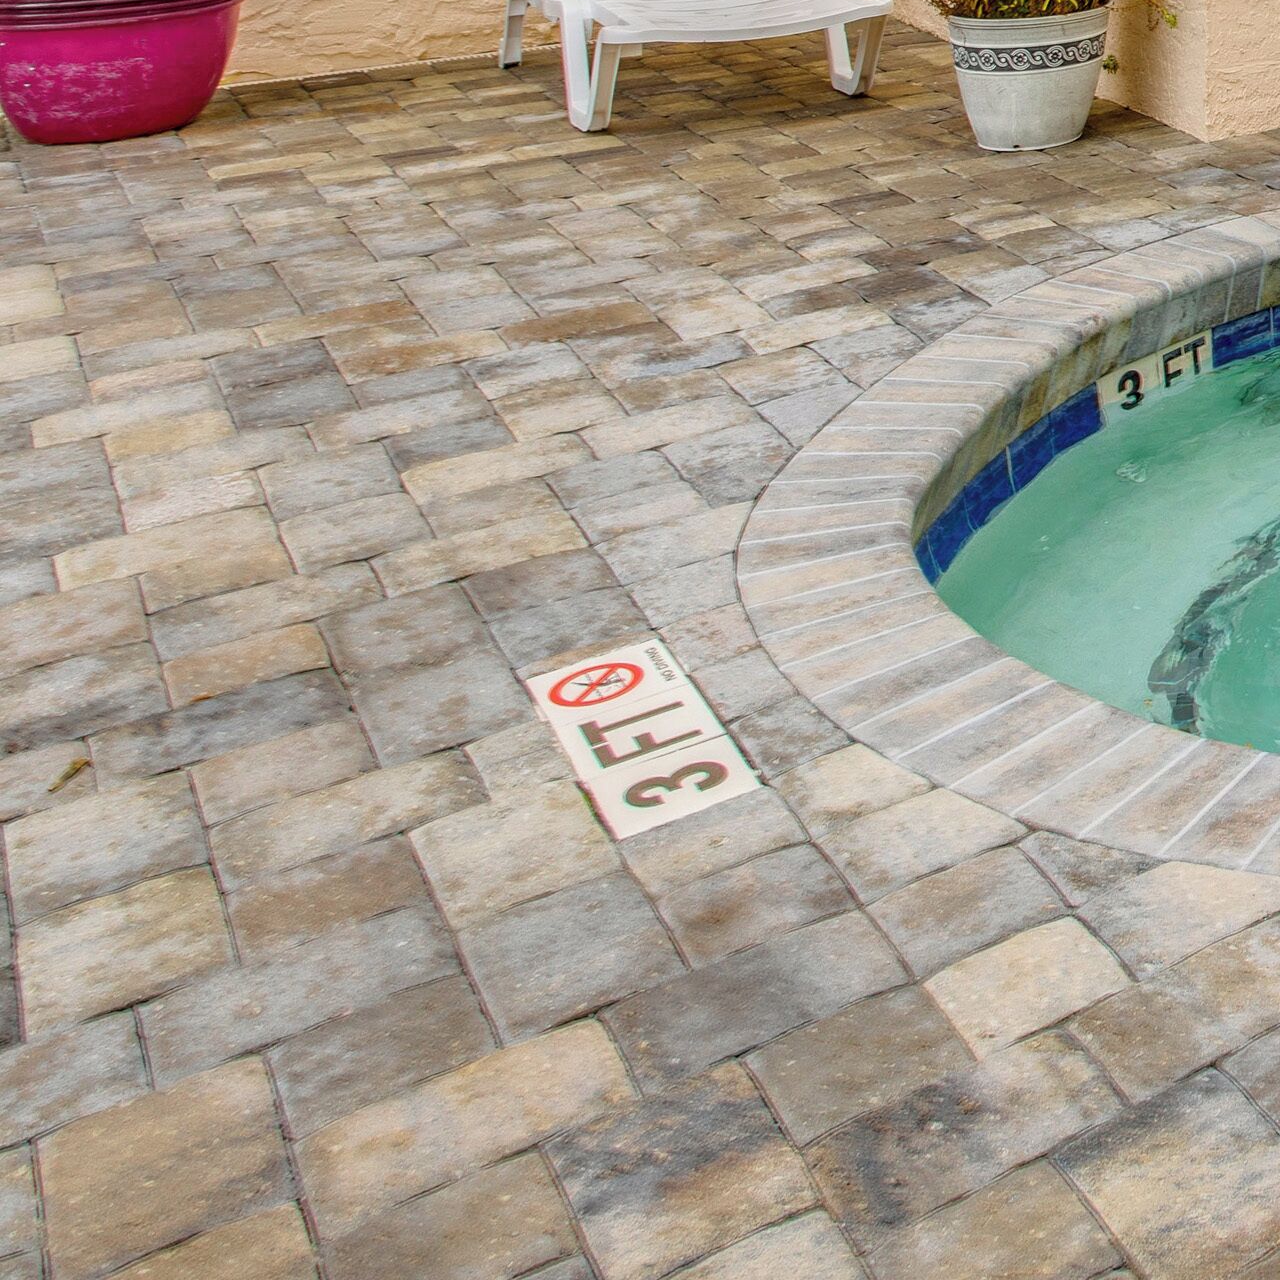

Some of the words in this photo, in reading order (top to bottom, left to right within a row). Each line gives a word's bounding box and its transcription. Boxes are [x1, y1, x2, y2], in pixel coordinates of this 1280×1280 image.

[1117, 369, 1144, 410] 3
[1162, 335, 1205, 388] FT
[660, 669, 678, 682] NO
[577, 700, 704, 769] FT
[623, 760, 729, 808] 3
